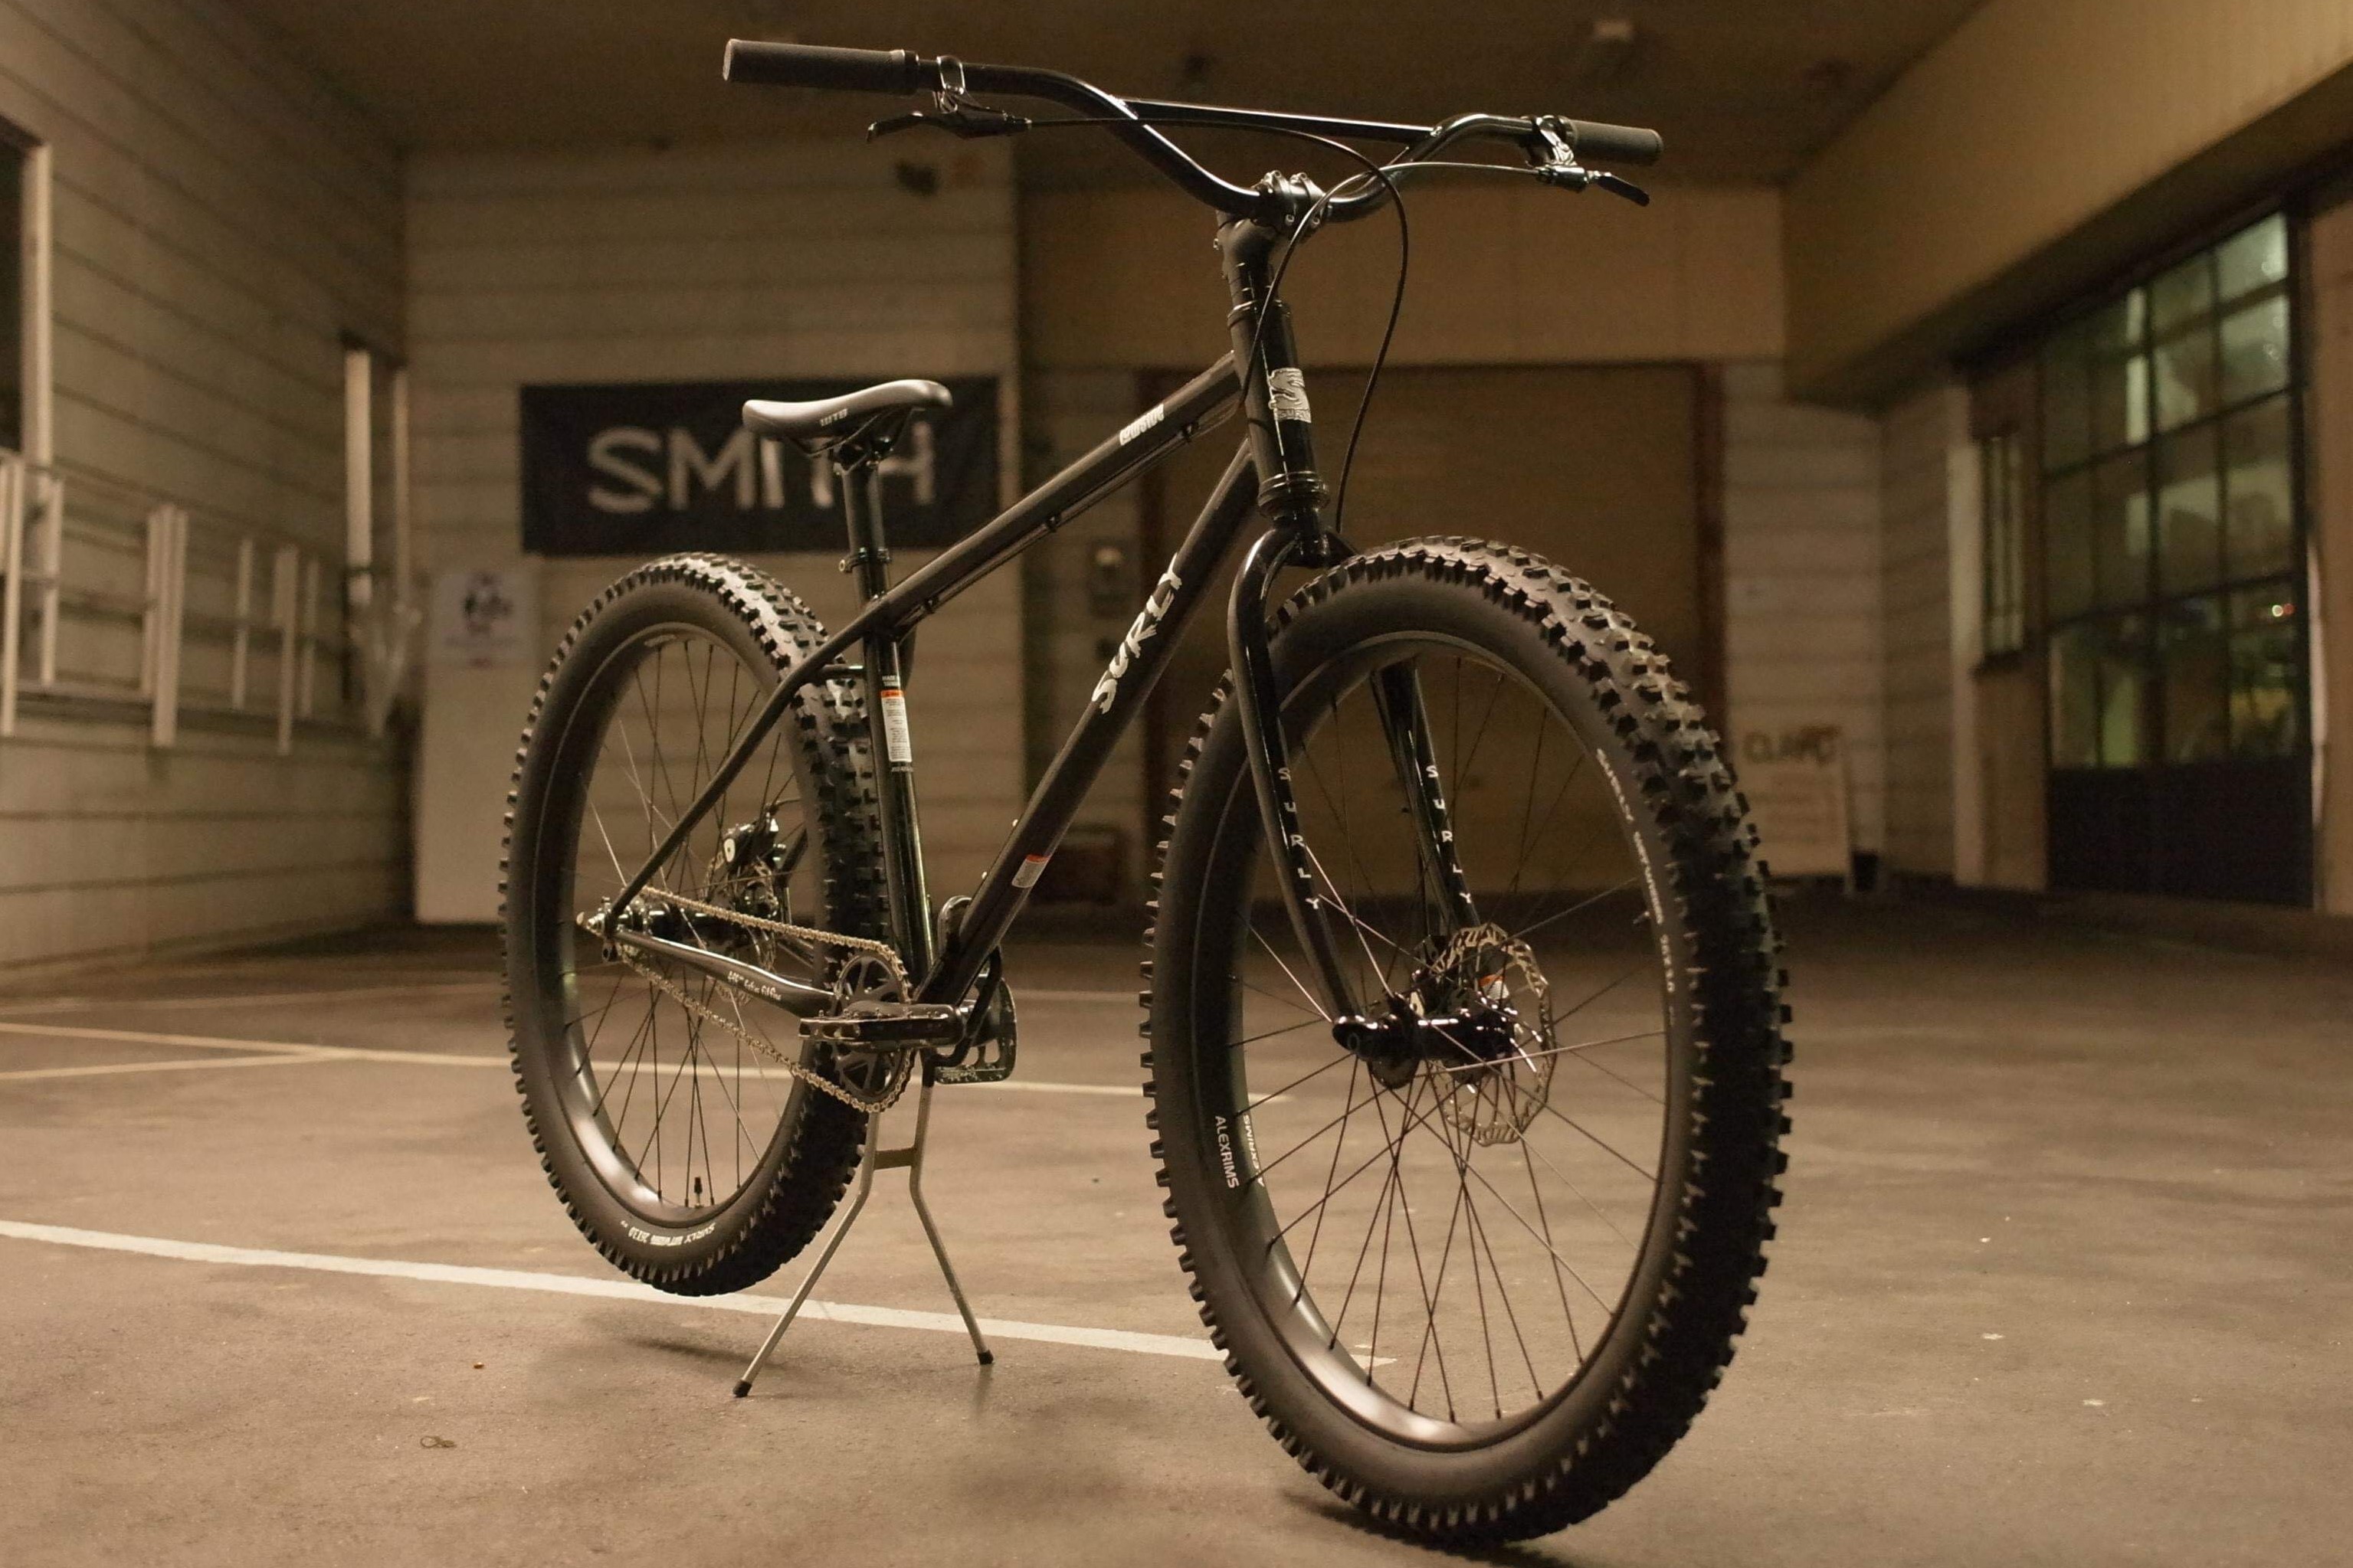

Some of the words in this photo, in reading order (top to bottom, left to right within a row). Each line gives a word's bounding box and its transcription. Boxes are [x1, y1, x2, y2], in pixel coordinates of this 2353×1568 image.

[820, 408, 848, 427] WTB
[588, 424, 936, 512] SMITH
[1092, 552, 1182, 714] SURLY
[1277, 767, 1319, 910] SURLY
[1425, 764, 1473, 904] SURLY
[1214, 1115, 1240, 1189] ALEXRIMS
[683, 1223, 716, 1244] SURLY
